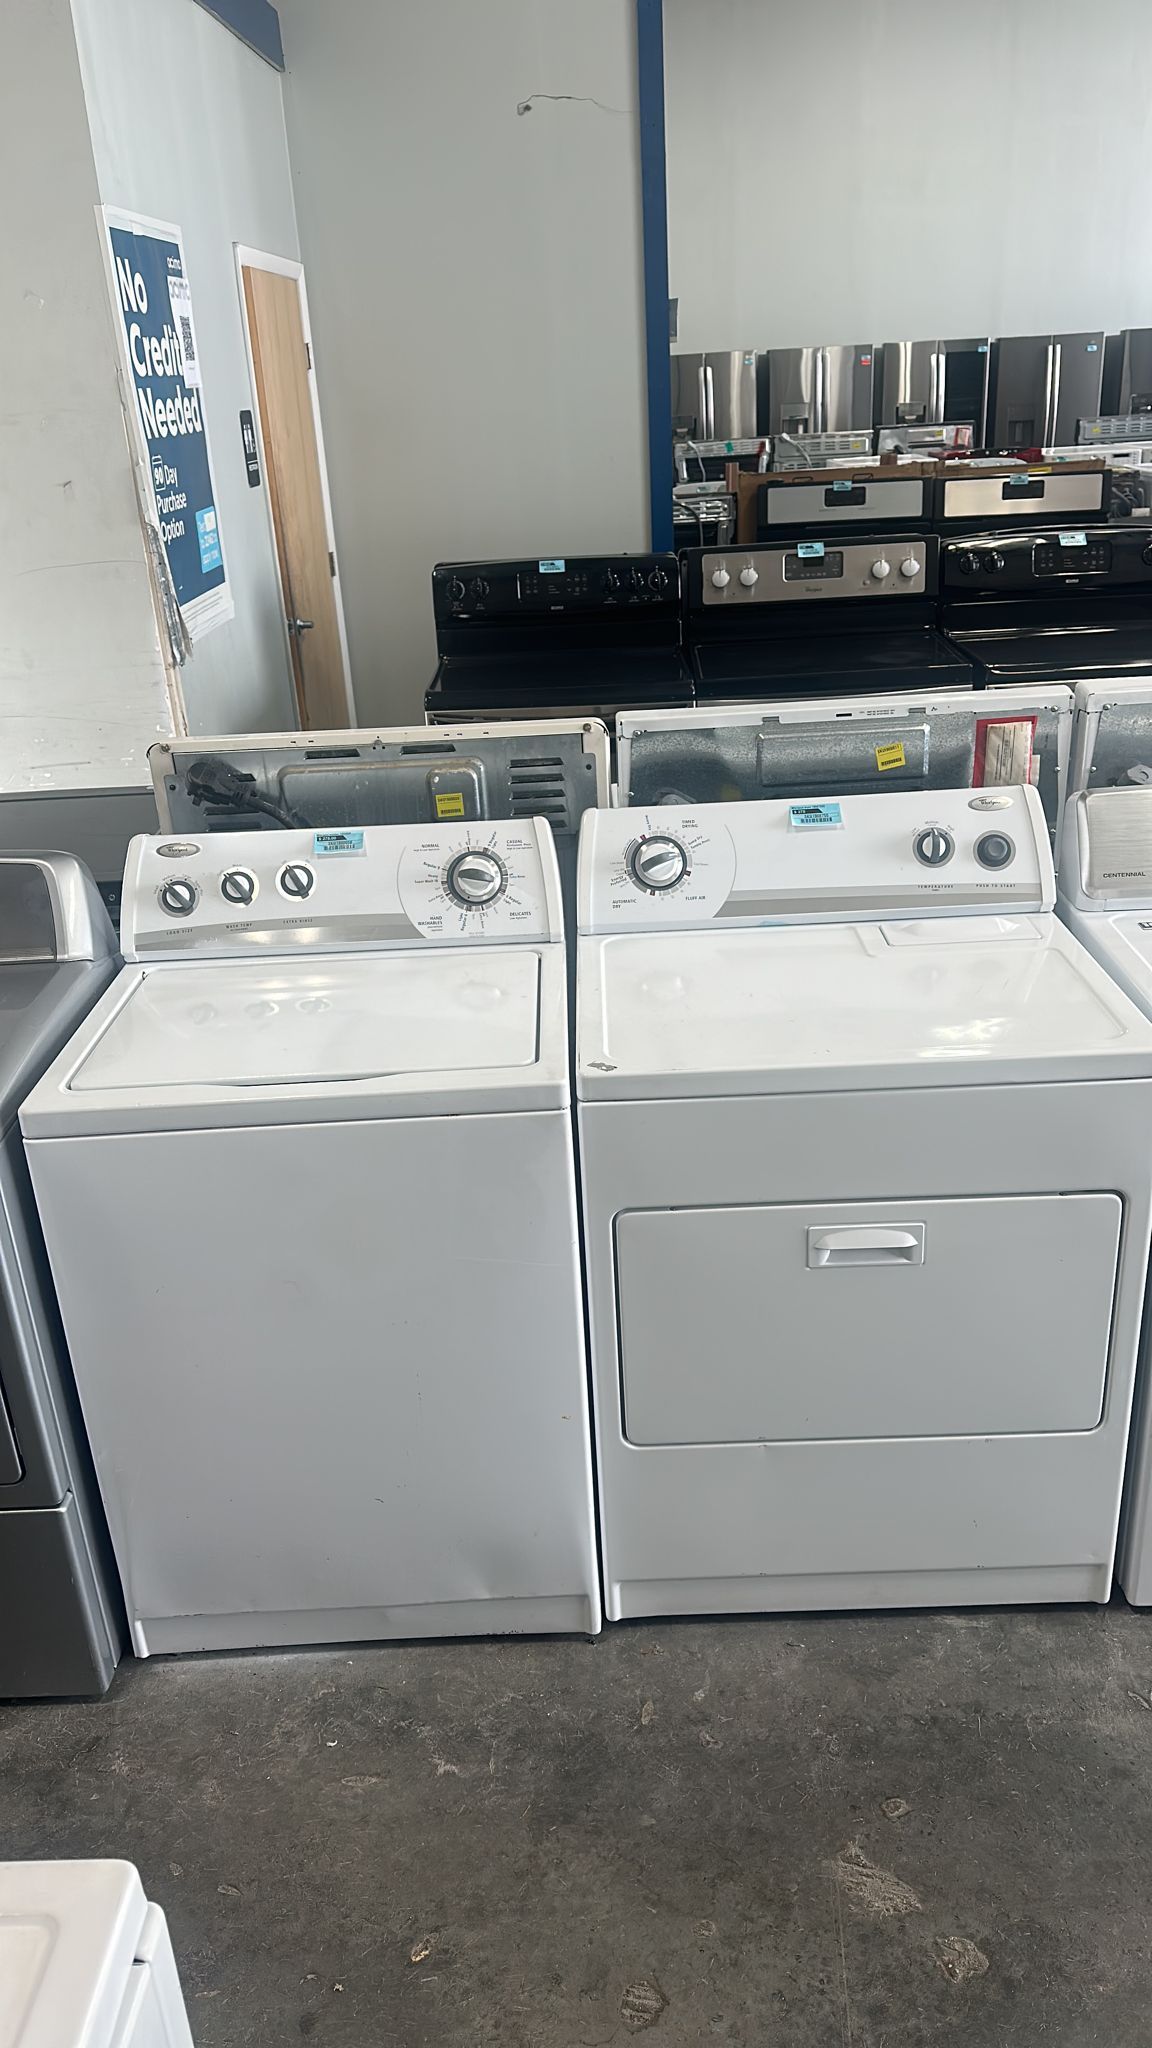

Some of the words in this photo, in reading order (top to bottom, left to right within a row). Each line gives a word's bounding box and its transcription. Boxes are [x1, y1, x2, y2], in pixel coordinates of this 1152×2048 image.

[116, 256, 148, 314] No
[129, 323, 183, 378] Credit
[138, 385, 202, 440] Needed
[154, 466, 164, 485] 90
[164, 464, 178, 487] Day
[156, 490, 187, 515] Purchase
[160, 517, 185, 546] Option
[1102, 871, 1147, 879] CENTENNIAL
